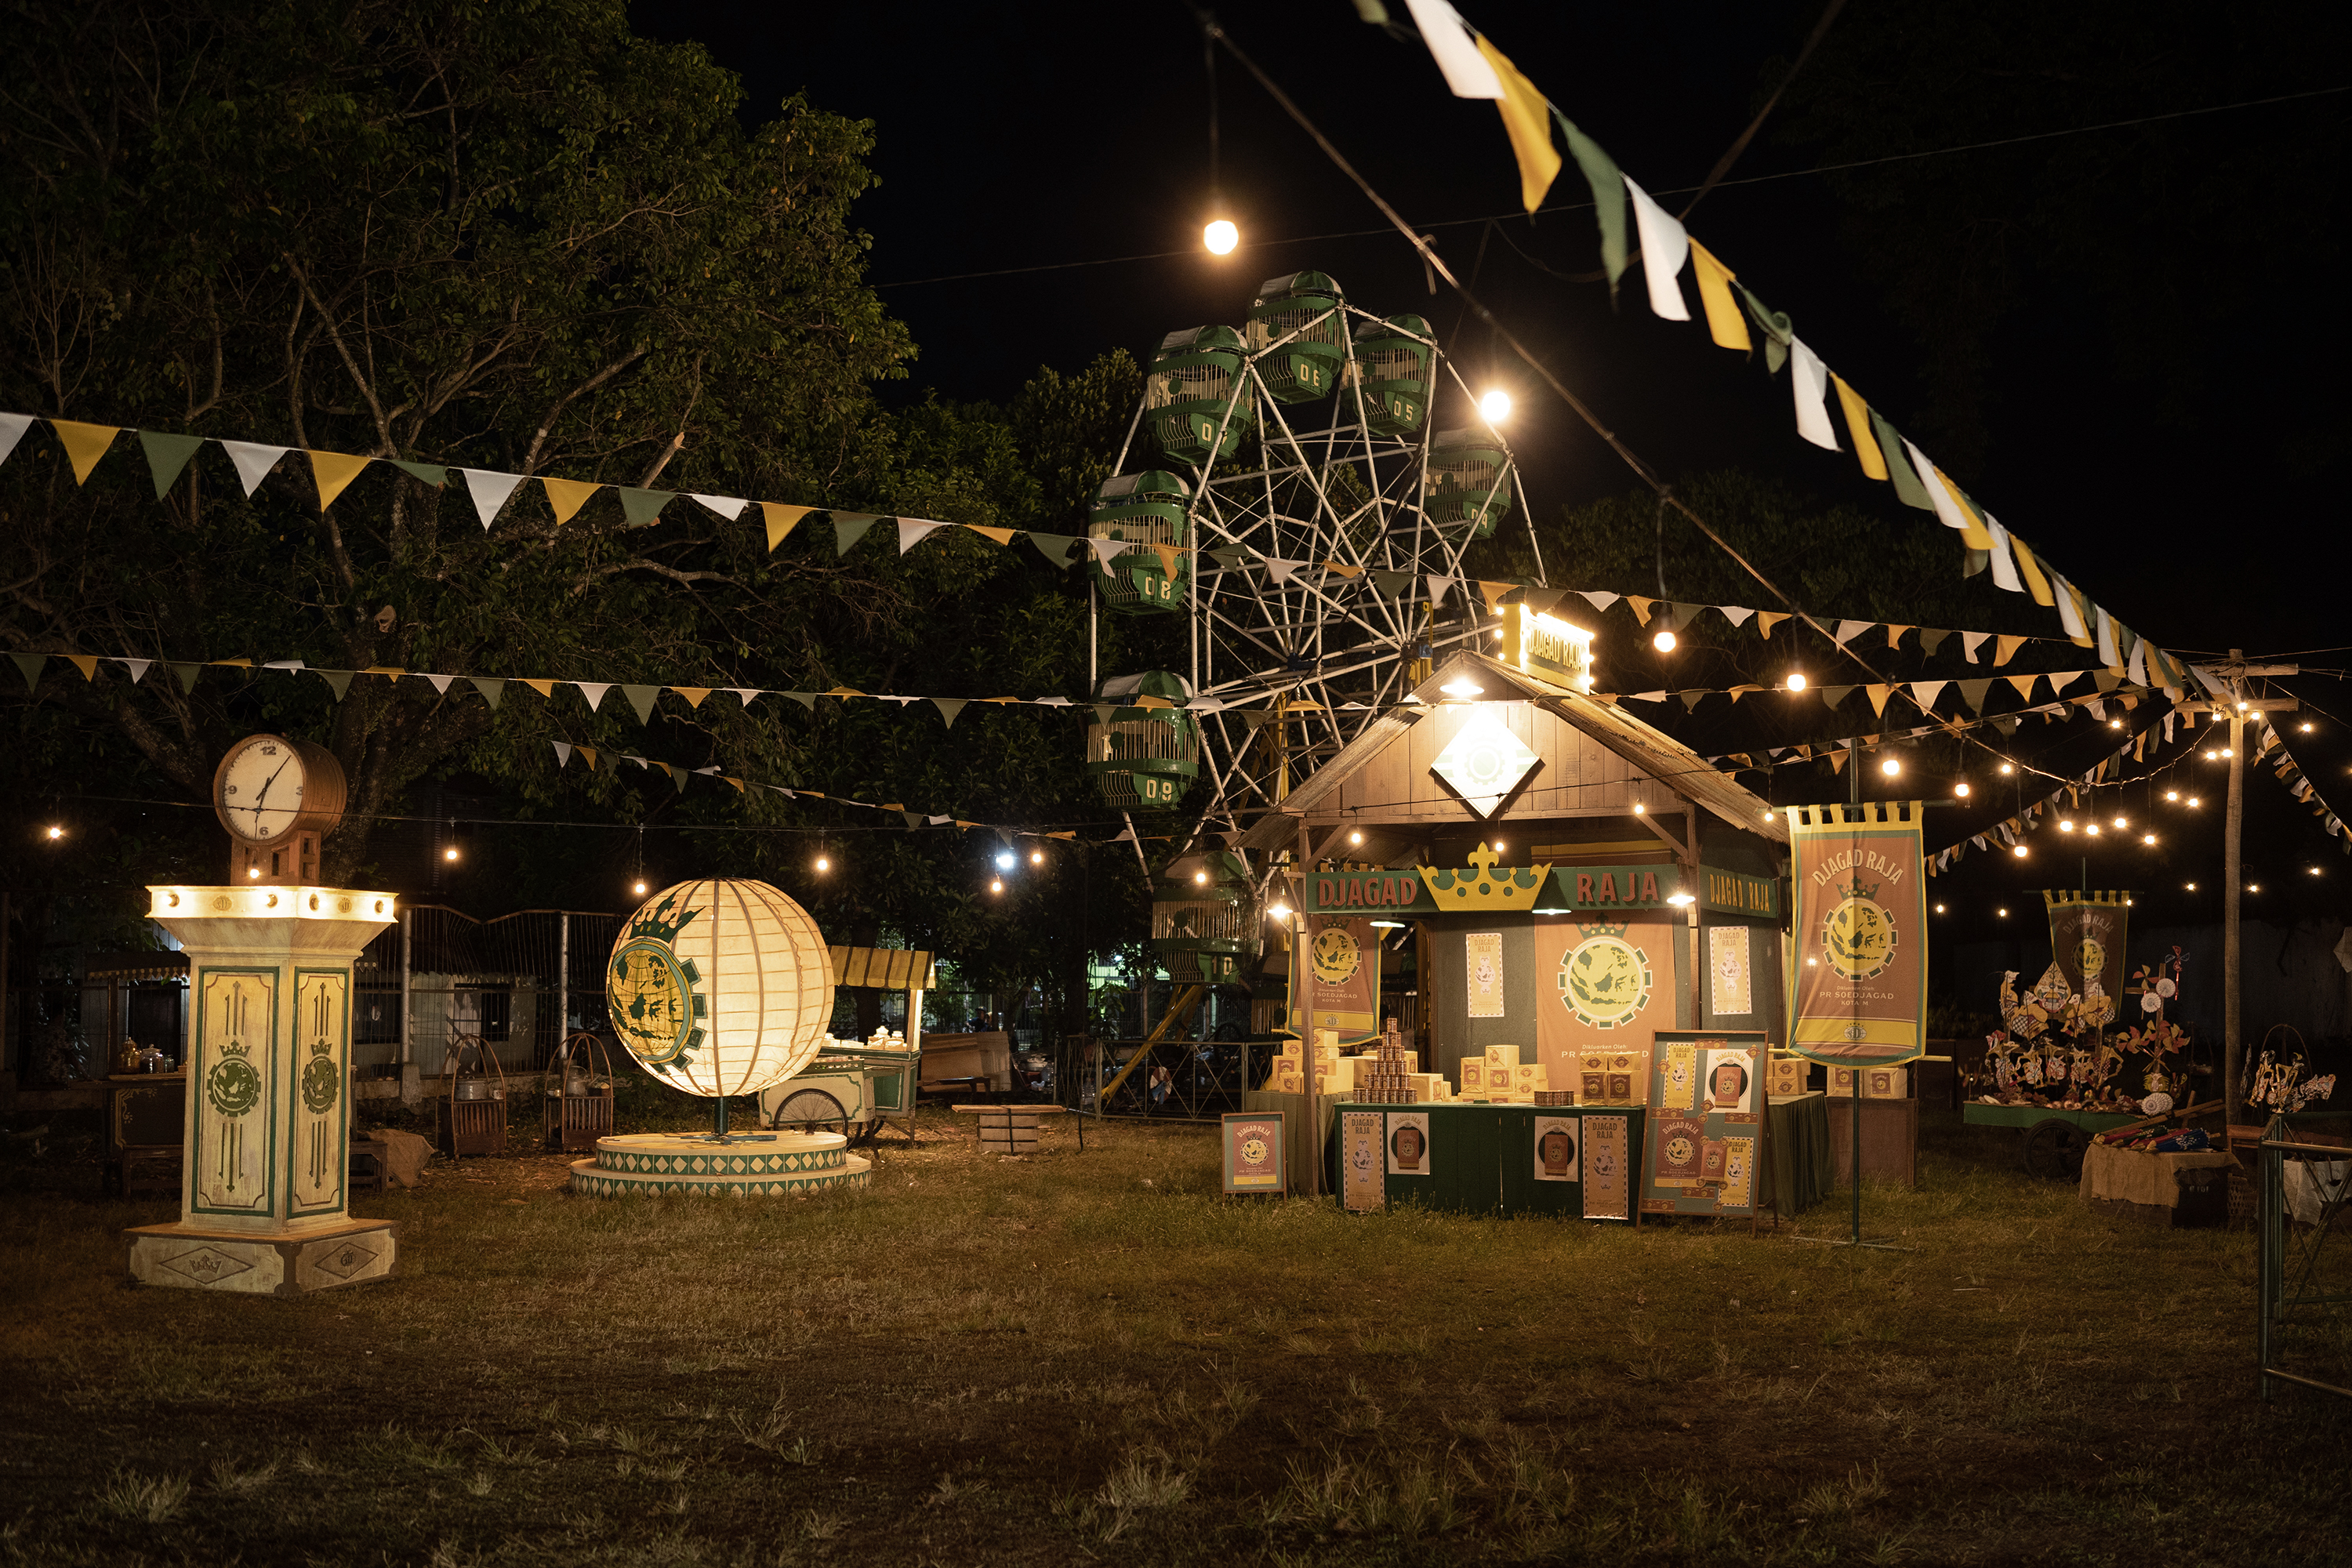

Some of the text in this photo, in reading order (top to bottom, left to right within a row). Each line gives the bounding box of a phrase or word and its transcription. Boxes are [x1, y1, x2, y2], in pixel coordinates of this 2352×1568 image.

[1300, 364, 1320, 387] 06
[1394, 400, 1414, 422] 05
[1145, 576, 1171, 601] 08
[1528, 627, 1583, 672] DJAGAD RAJA
[260, 746, 277, 756] 12
[228, 785, 238, 795] 9
[1146, 779, 1172, 801] 09
[260, 826, 269, 836] 6
[1812, 848, 1904, 887] DJAGAD RAJA
[1319, 877, 1417, 906] DJAGAD
[1577, 872, 1660, 902] RAJA
[1710, 873, 1770, 913] DJAGAD RAJA
[2092, 914, 2114, 933] RAJA
[1212, 956, 1232, 975] 10
[1835, 991, 1893, 1000] SOEDJAGAD
[1237, 1125, 1271, 1138] DJAGAD RAJA
[1662, 1121, 1699, 1134] DJAGAD RAJA
